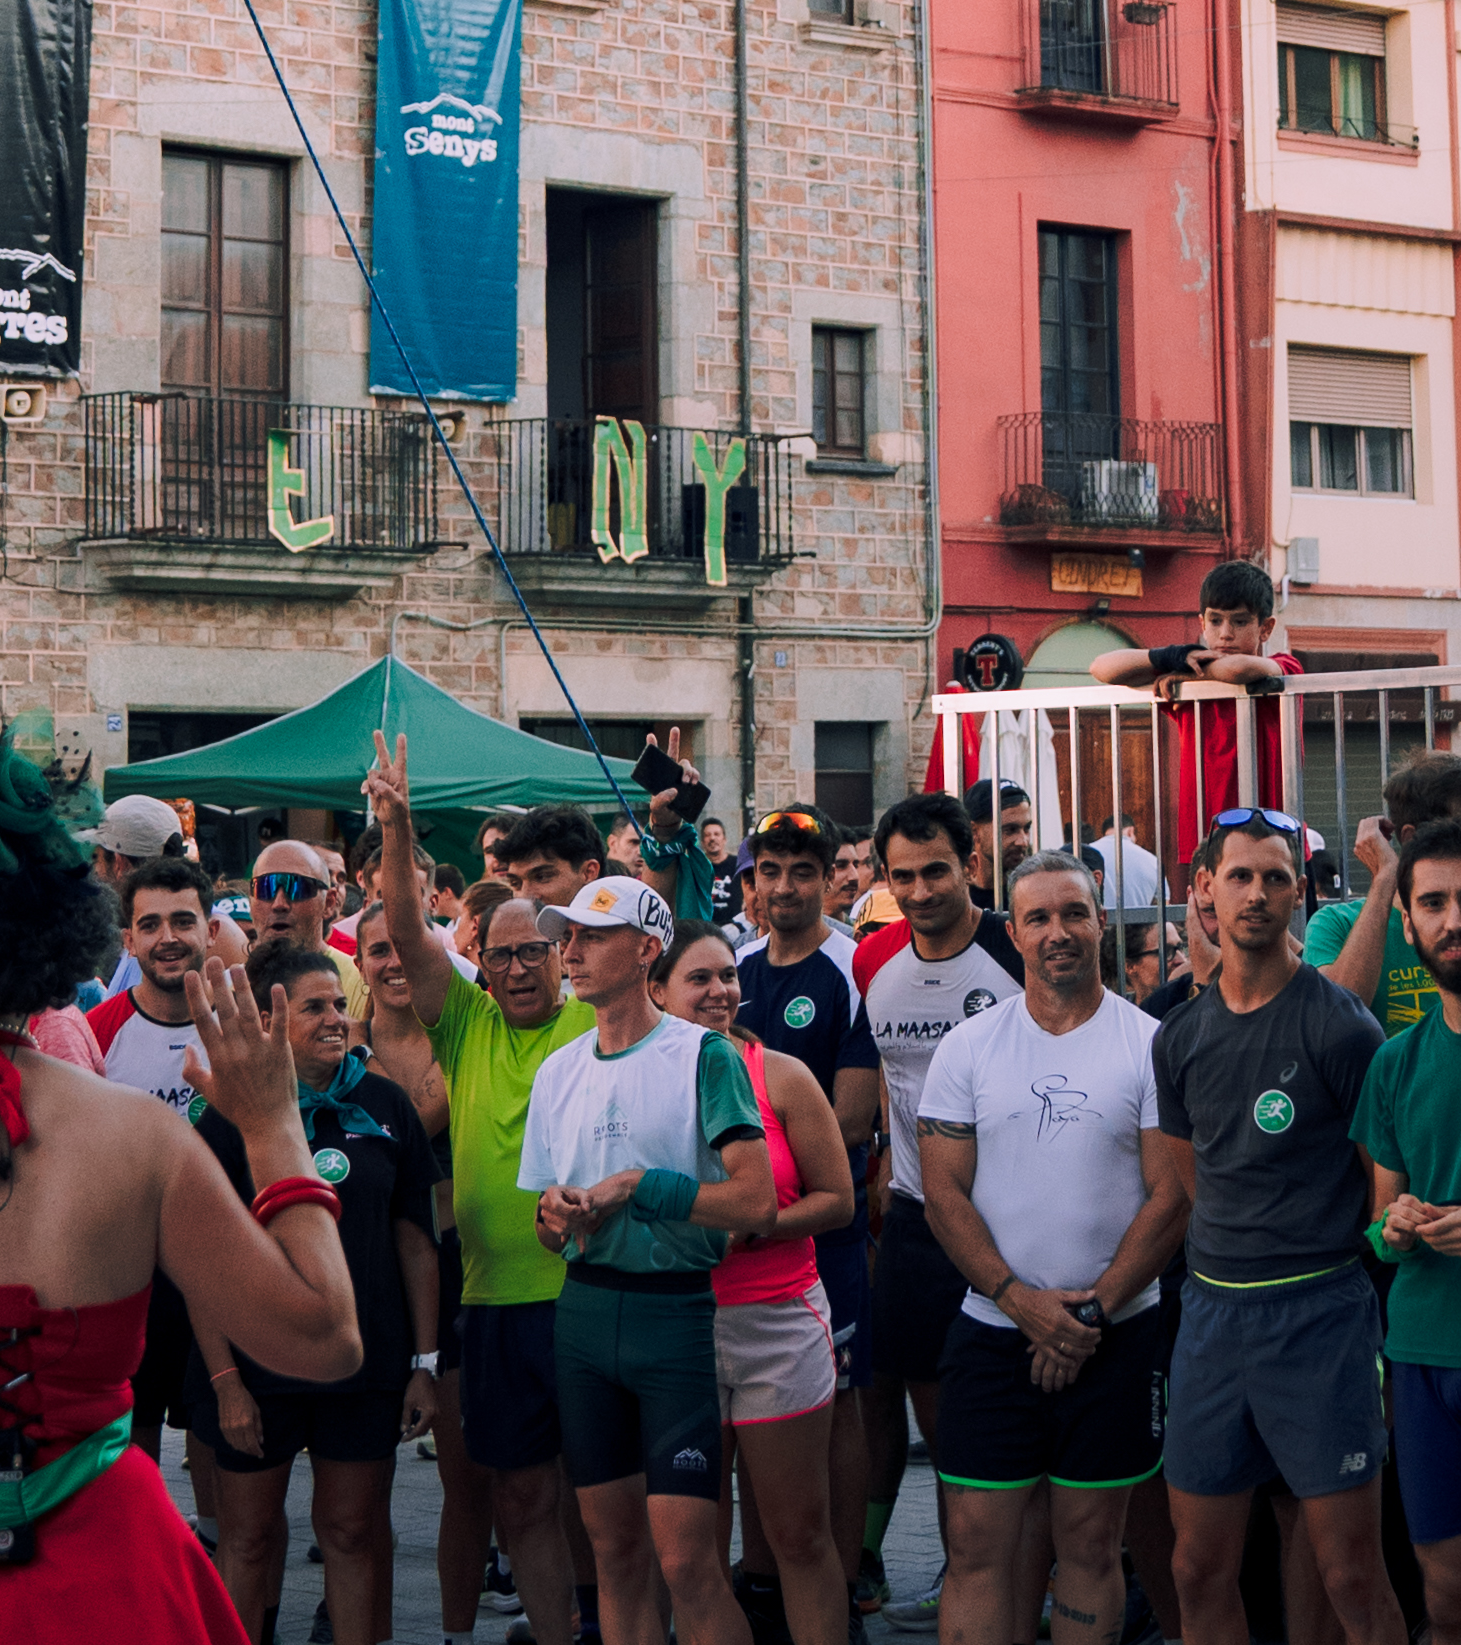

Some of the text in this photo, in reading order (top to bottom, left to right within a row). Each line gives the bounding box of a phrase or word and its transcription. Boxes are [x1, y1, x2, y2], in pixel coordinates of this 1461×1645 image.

[431, 114, 475, 134] mont
[404, 126, 498, 167] Senys
[876, 1021, 893, 1040] LA
